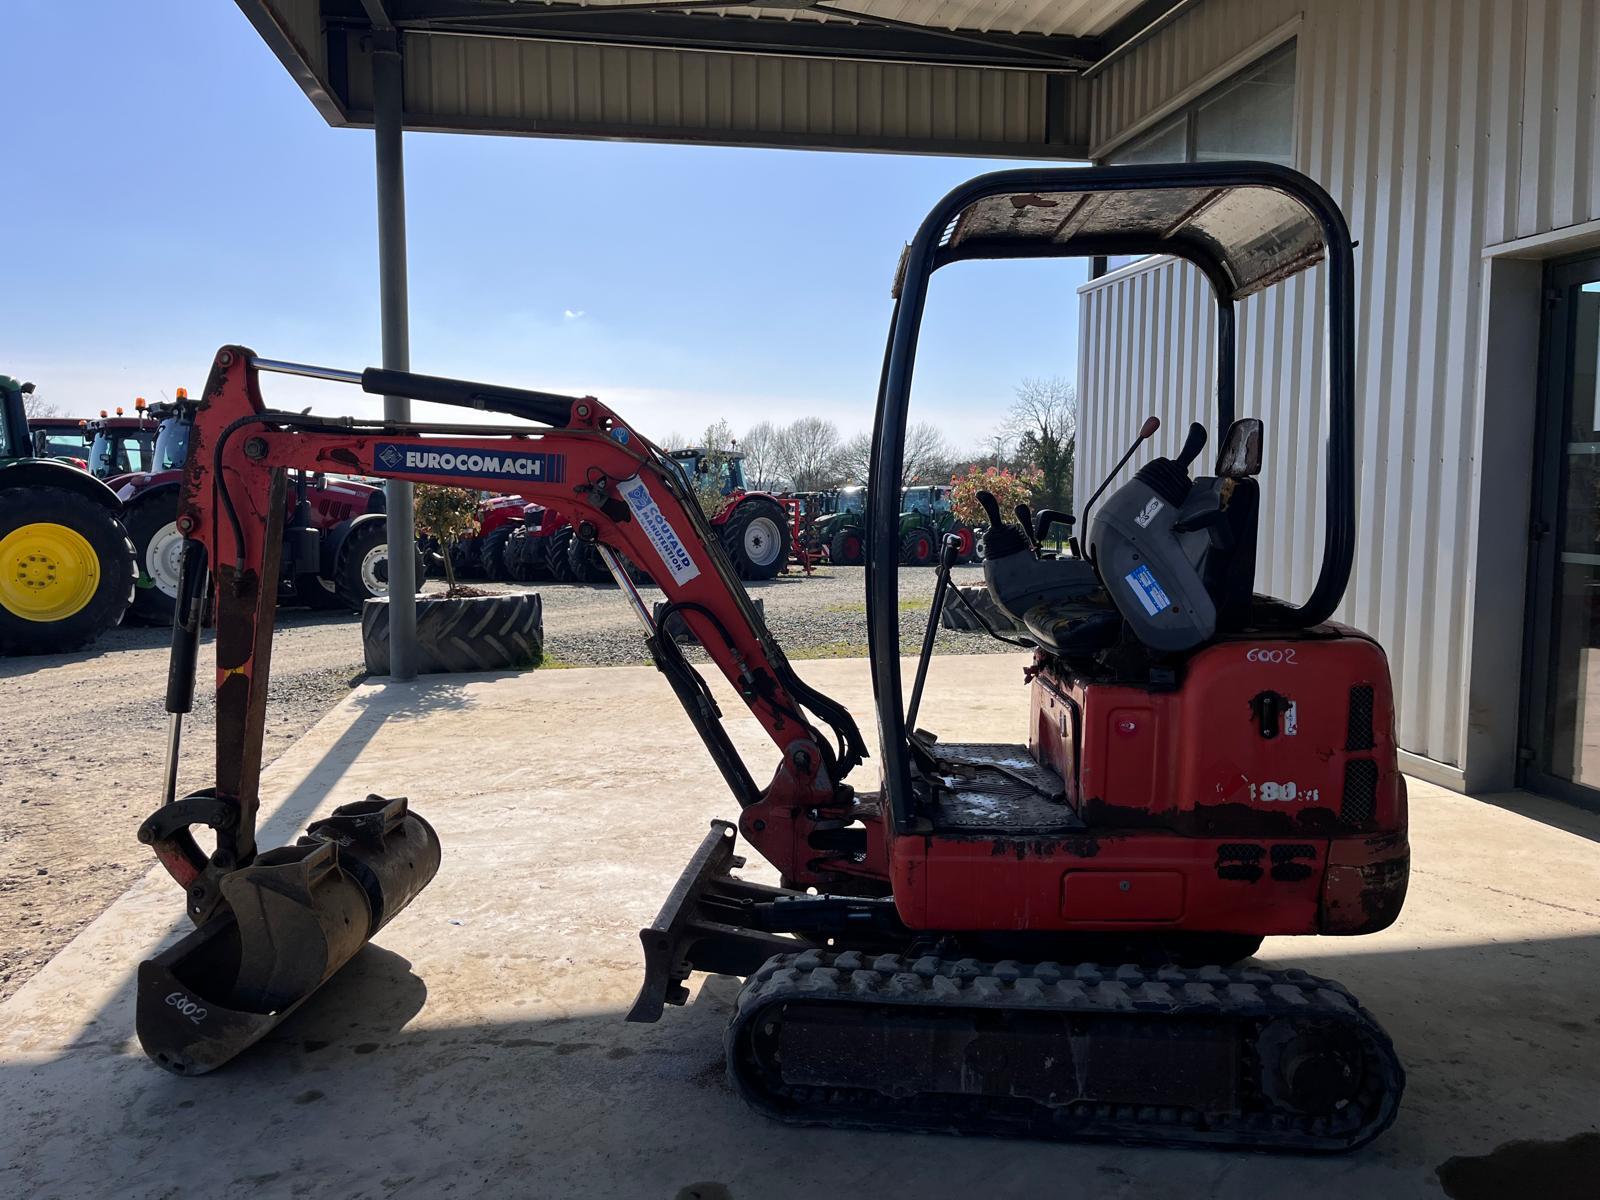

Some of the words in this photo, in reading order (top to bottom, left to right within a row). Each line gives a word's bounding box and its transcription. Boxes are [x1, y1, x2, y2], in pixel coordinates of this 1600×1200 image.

[406, 451, 541, 476] EUROCOMACH
[641, 511, 683, 572] MANUTENTION
[650, 507, 691, 567] COUTAUD
[1246, 648, 1299, 665] 6002
[164, 992, 208, 1024] 6002
